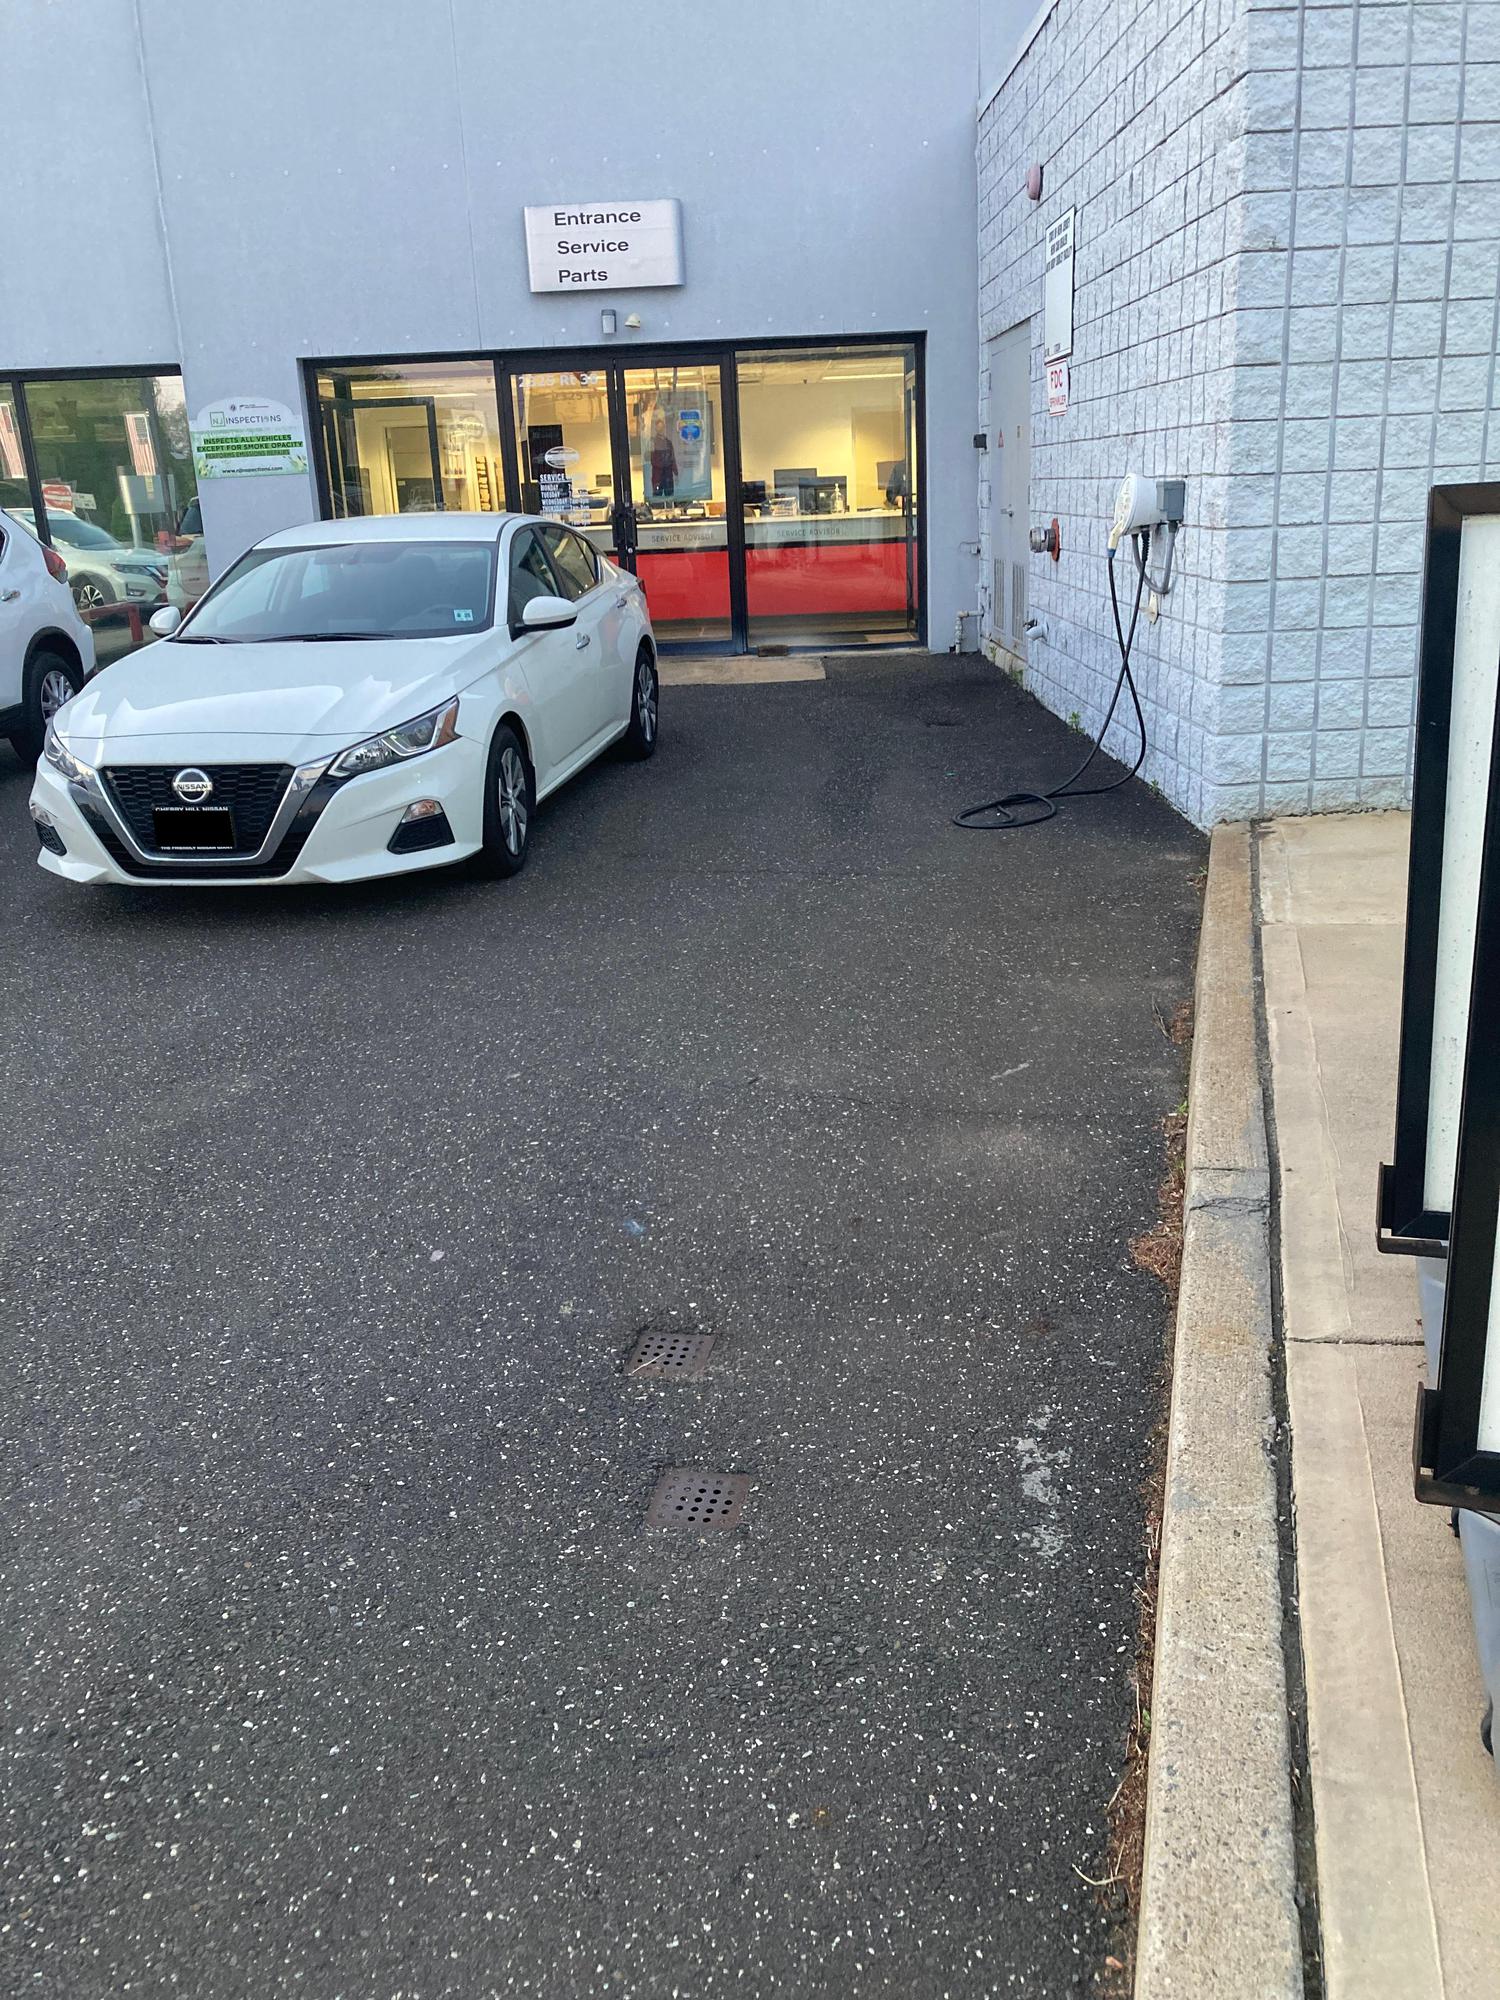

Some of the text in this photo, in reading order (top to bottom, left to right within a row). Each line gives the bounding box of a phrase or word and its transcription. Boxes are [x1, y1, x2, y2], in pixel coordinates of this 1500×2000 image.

[554, 211, 642, 226] Entrance
[557, 239, 629, 255] Service
[558, 269, 608, 283] Parts
[1051, 368, 1063, 389] FDC
[256, 434, 291, 442] VEHICLES
[539, 473, 565, 482] SERVICE
[776, 529, 806, 537] SERVICE
[652, 535, 680, 544] SERVICE
